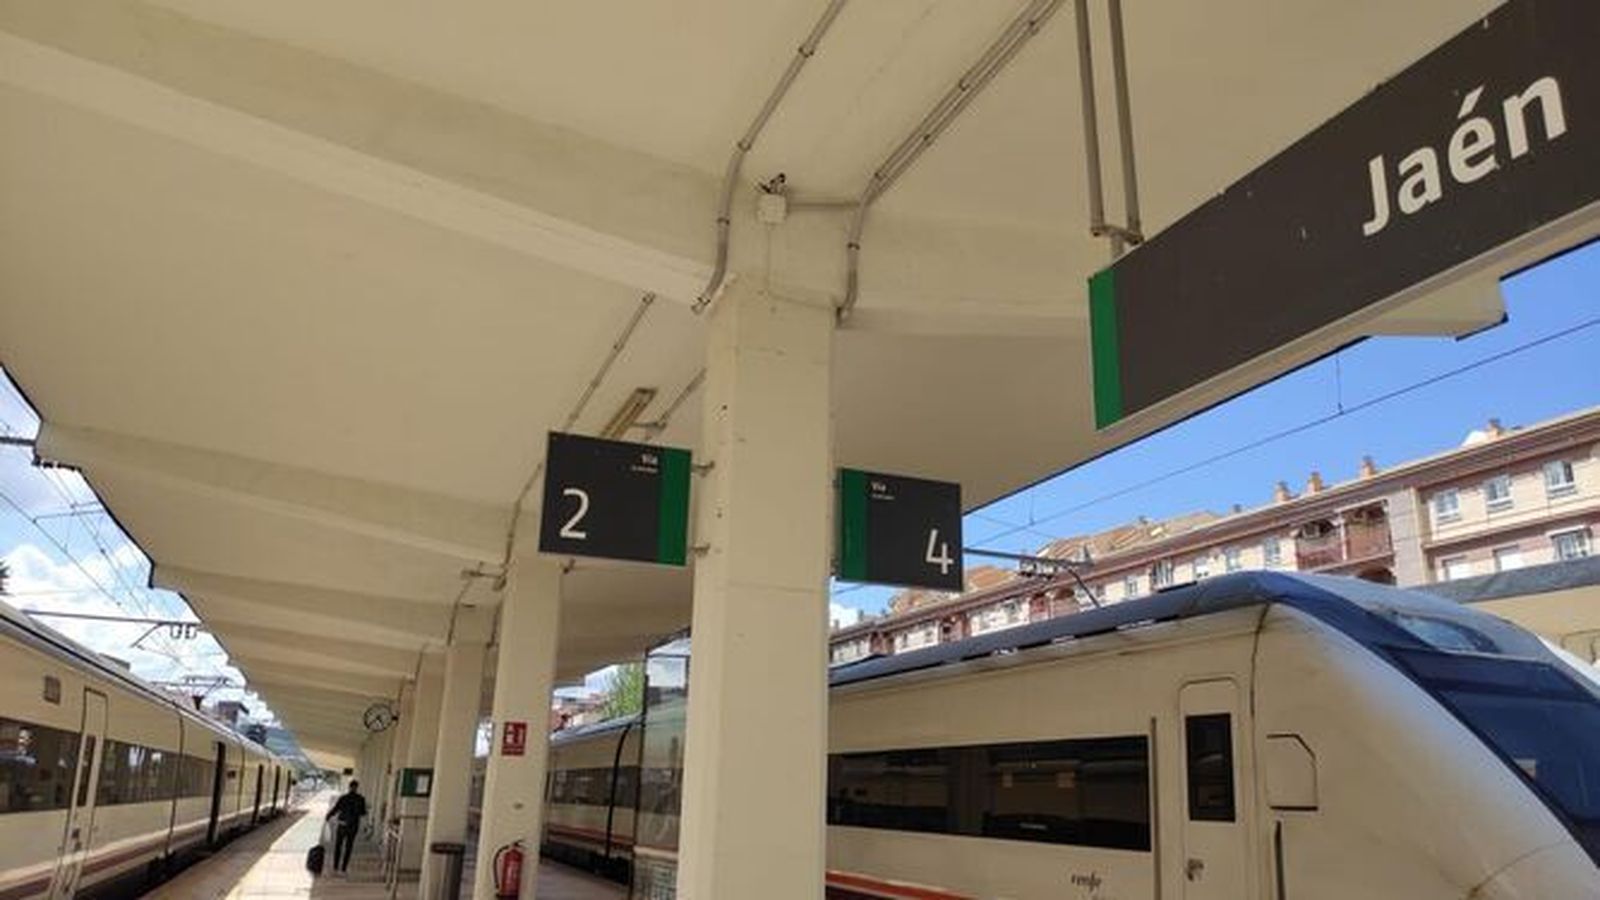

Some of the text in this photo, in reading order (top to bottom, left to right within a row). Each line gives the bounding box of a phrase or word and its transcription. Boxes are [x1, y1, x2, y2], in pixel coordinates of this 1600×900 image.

[1362, 75, 1567, 237] Jaén
[560, 488, 589, 538] 2
[926, 529, 954, 575] 4
